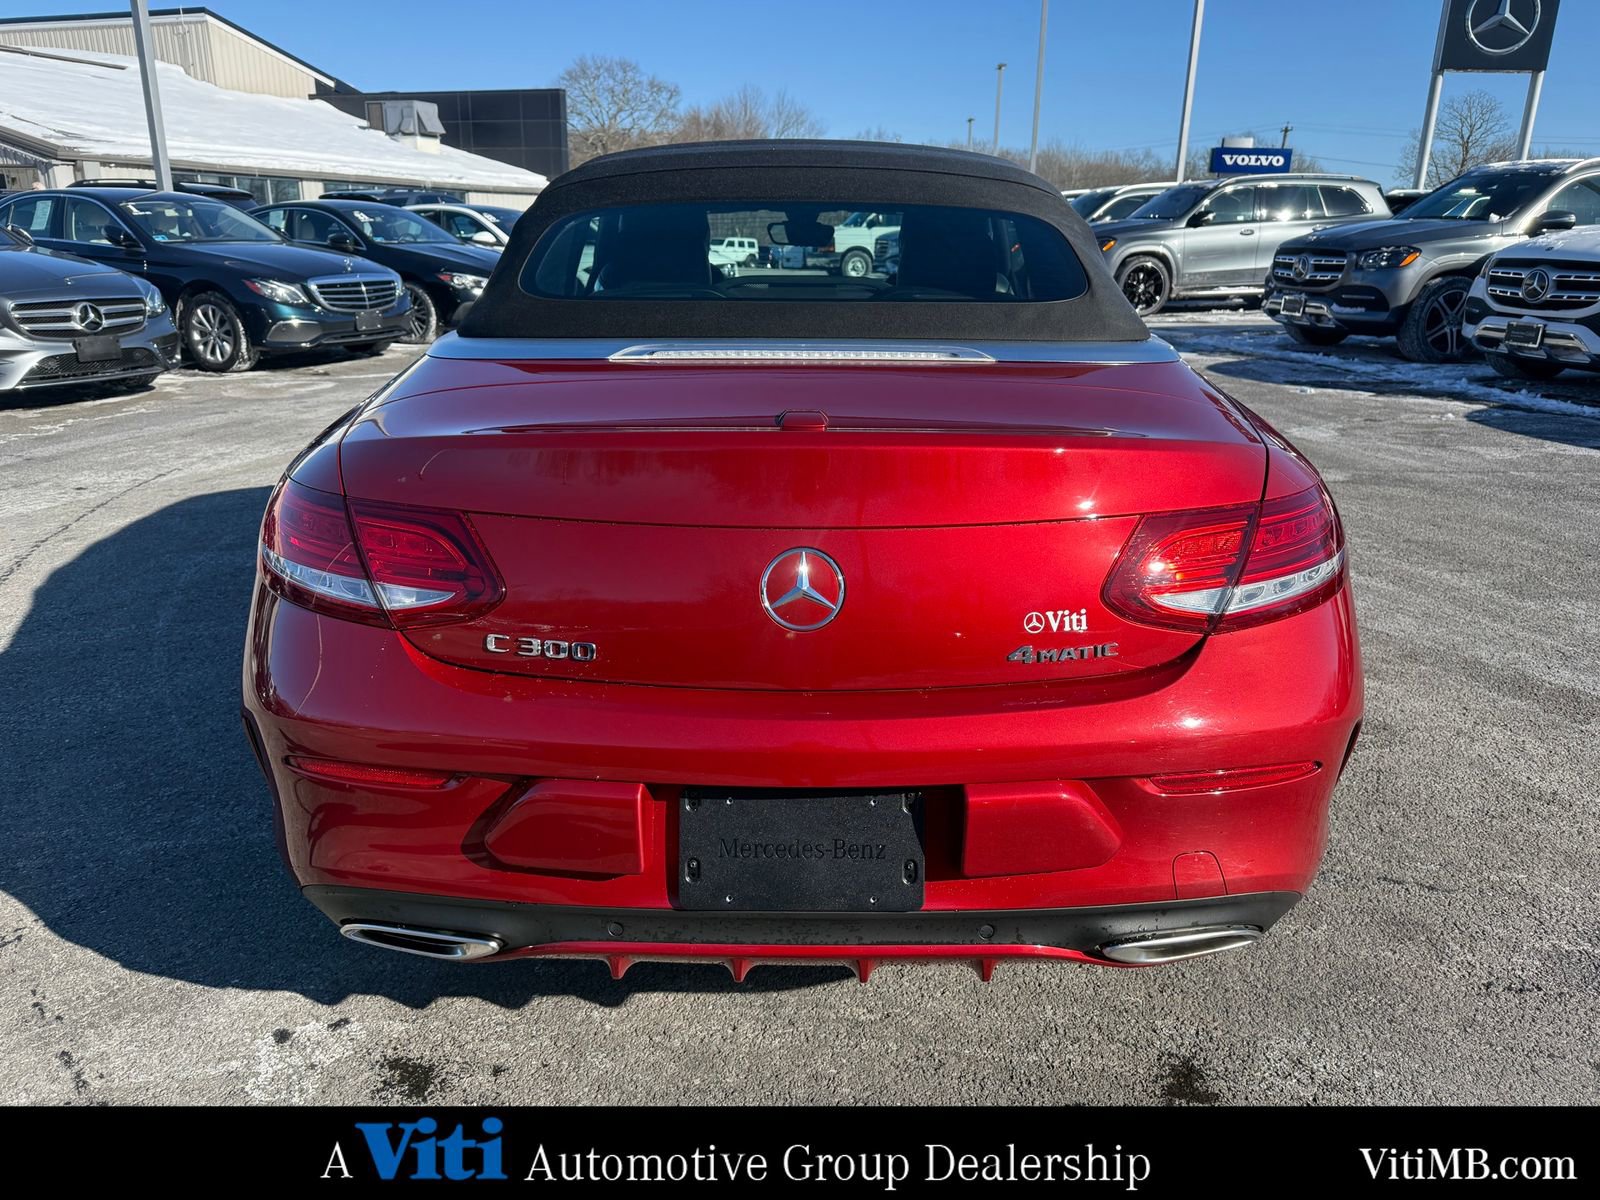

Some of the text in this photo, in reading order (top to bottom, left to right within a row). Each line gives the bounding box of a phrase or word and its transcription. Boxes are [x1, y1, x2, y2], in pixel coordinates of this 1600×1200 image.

[1221, 154, 1285, 167] VOLVO
[1045, 608, 1088, 633] Viti
[485, 633, 597, 661] C 300
[1007, 641, 1119, 664] 4MATIC
[718, 837, 887, 861] Mercedes-Benz
